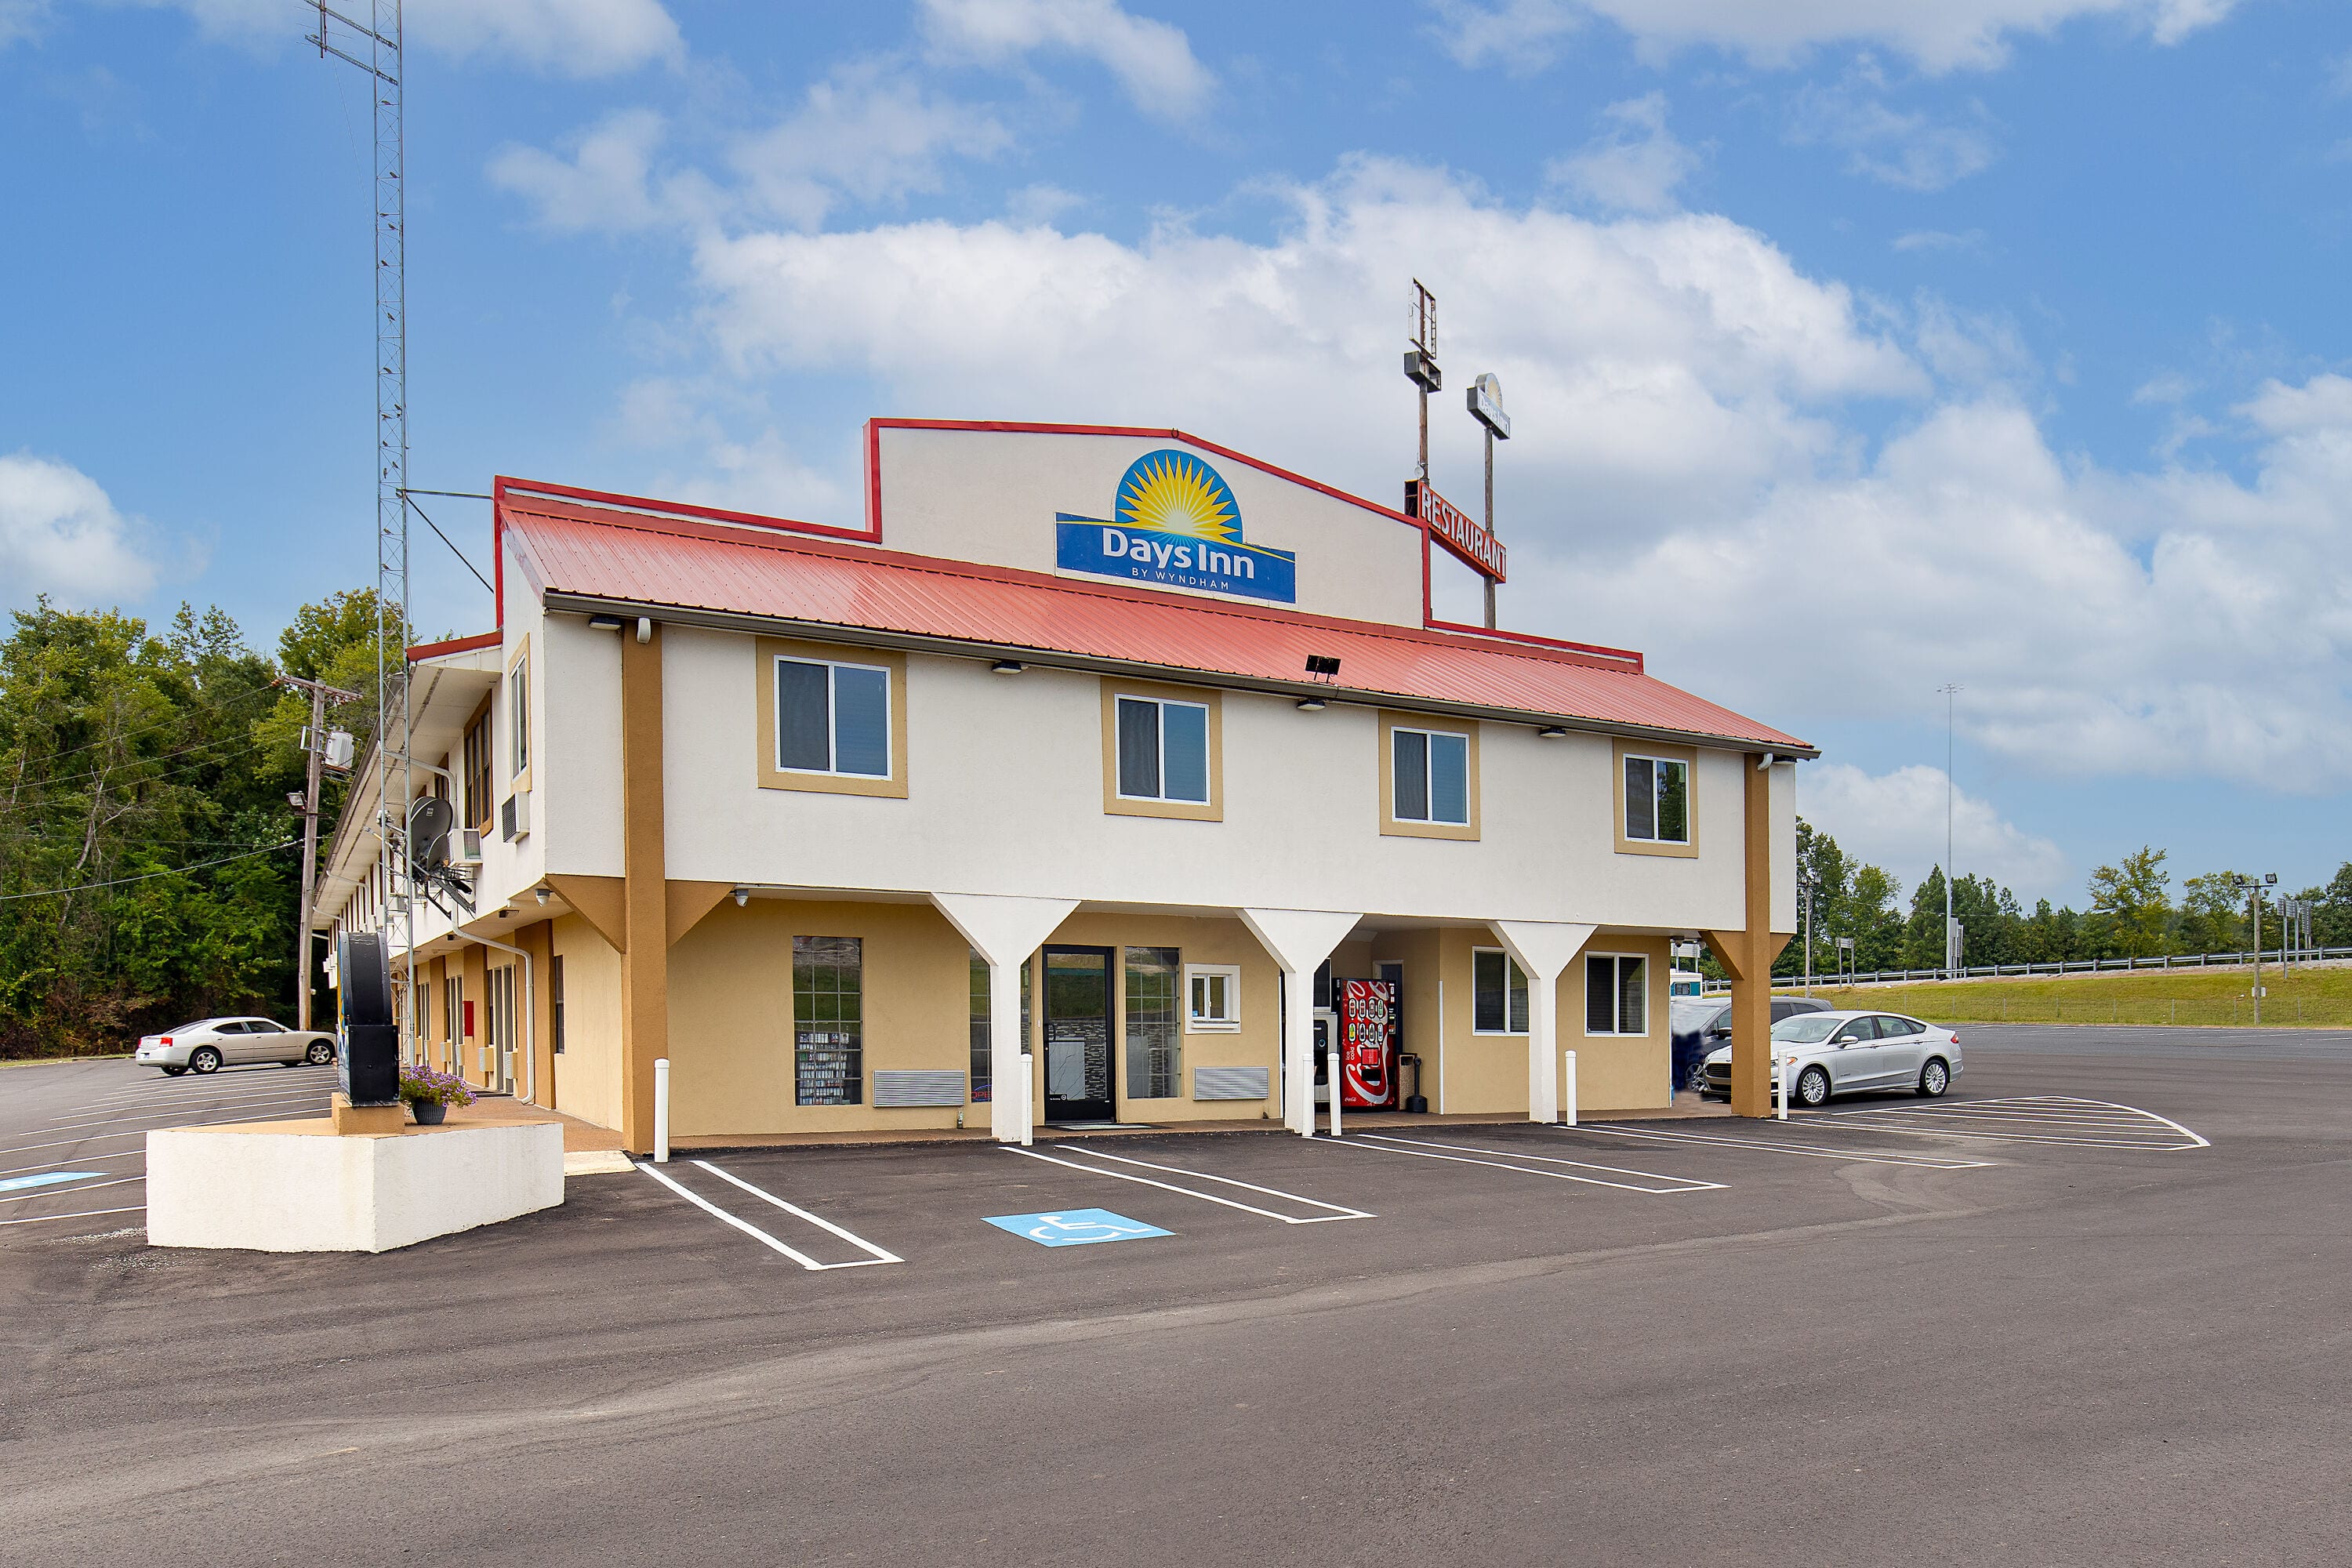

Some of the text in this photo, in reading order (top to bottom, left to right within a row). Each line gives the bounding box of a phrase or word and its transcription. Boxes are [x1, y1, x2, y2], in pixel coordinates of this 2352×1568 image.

[1479, 393, 1509, 434] Days Inn
[1102, 528, 1254, 579] Days Inn
[1421, 486, 1507, 577] RESTAURANT
[1132, 568, 1229, 590] BY WYNDHAM
